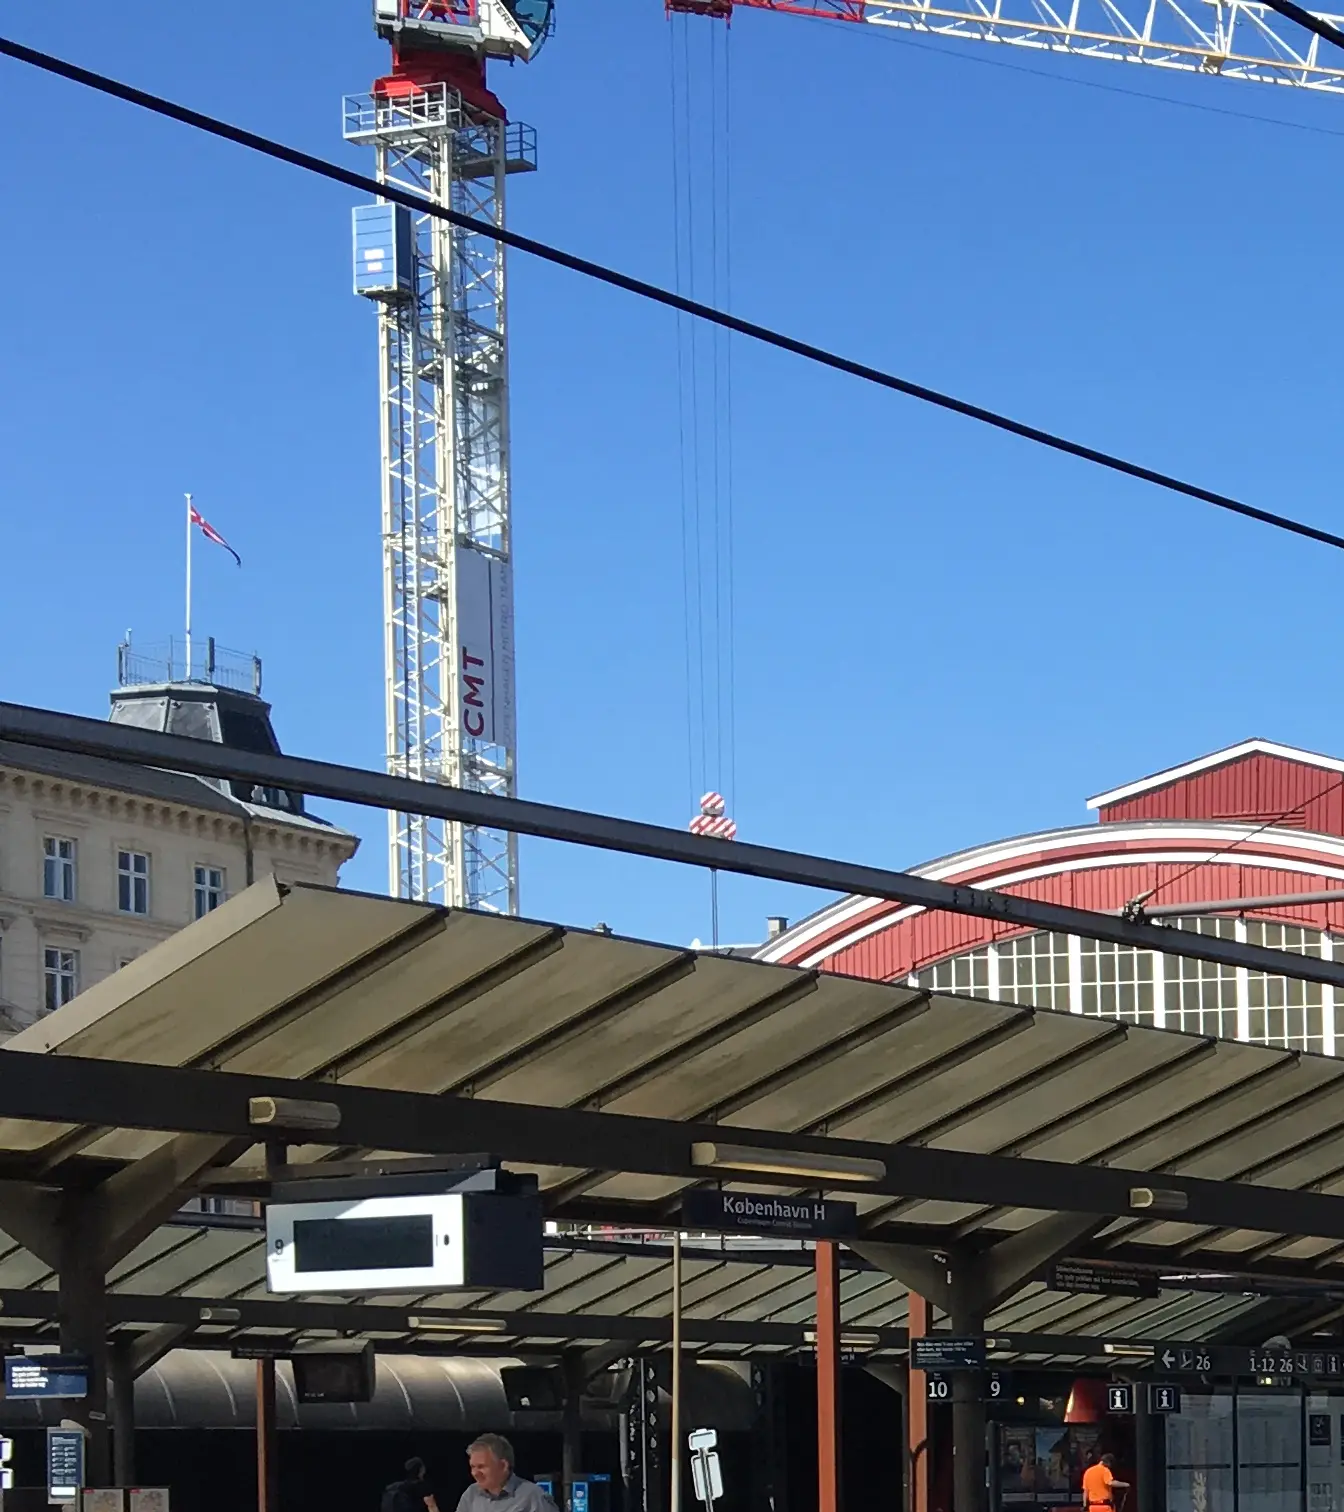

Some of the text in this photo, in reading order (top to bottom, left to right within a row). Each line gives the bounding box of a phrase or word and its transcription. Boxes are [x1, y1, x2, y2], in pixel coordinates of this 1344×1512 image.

[493, 0, 520, 36] TEREX
[462, 645, 485, 737] CMT
[723, 1196, 825, 1221] København H
[1196, 1355, 1211, 1371] 26
[1250, 1357, 1293, 1373] 1-12 26
[928, 1381, 948, 1398] 10
[990, 1380, 1001, 1397] 9
